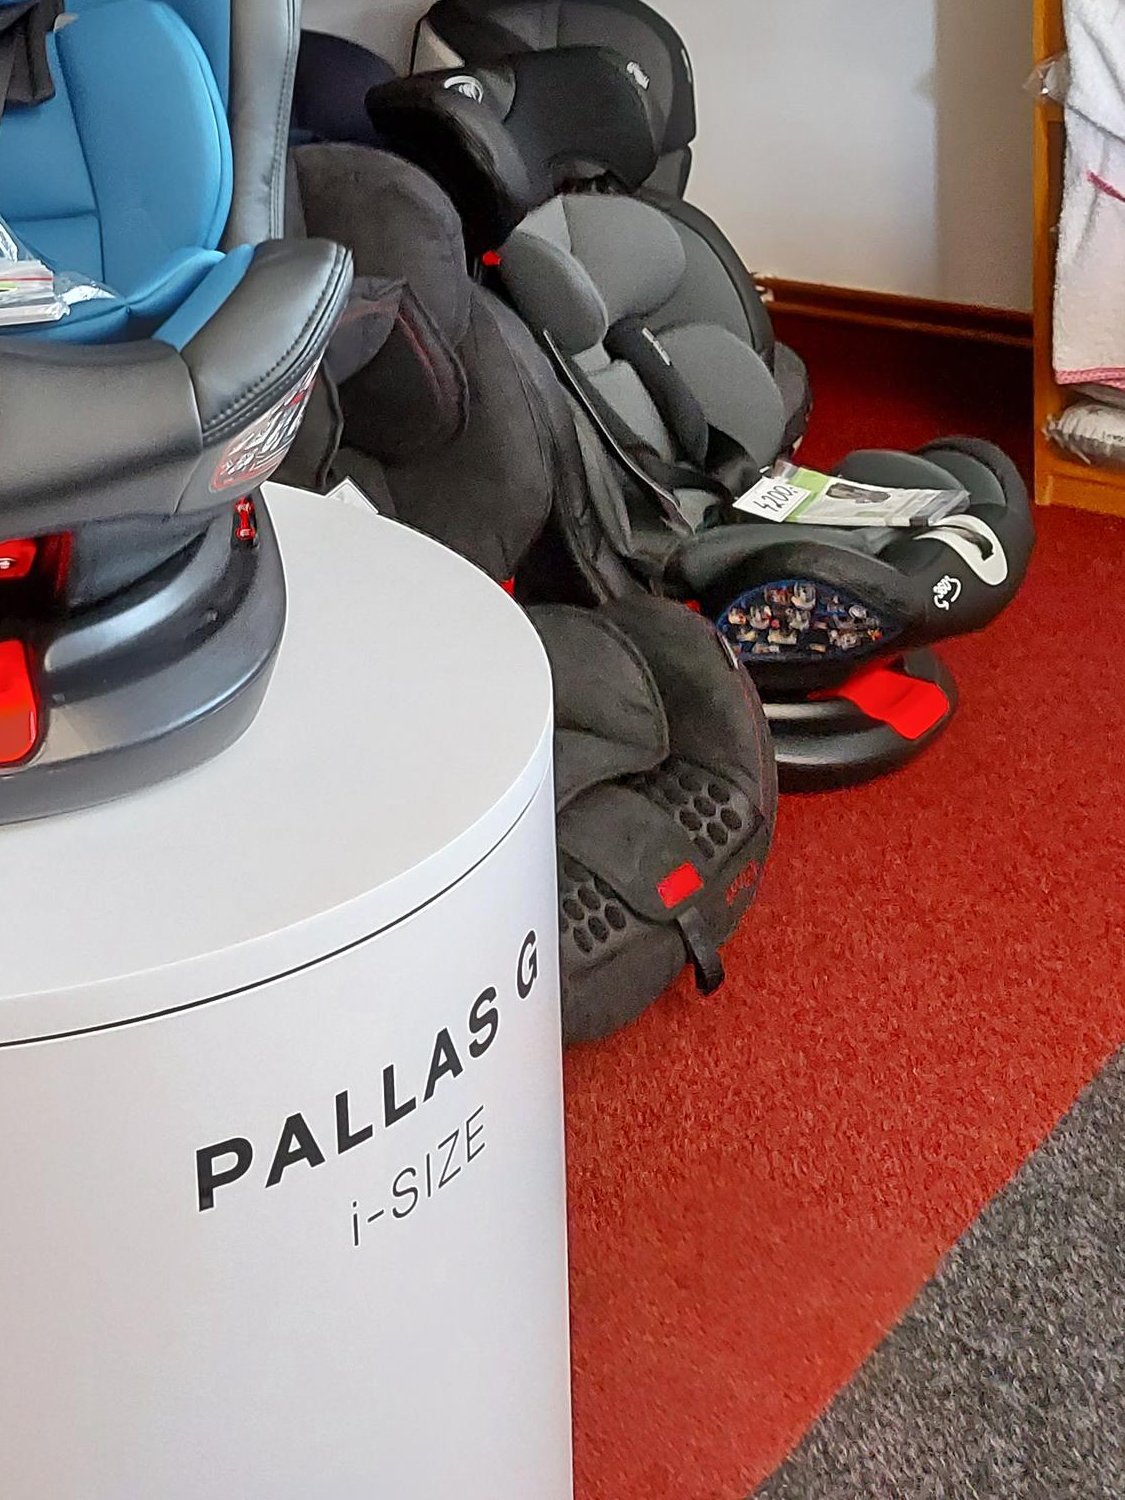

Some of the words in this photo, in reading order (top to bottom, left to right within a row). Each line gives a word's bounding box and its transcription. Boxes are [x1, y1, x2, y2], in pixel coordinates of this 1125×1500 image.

[195, 985, 500, 1213] PALLAS
[516, 929, 539, 1000] G
[351, 1104, 486, 1247] i-SIZE
